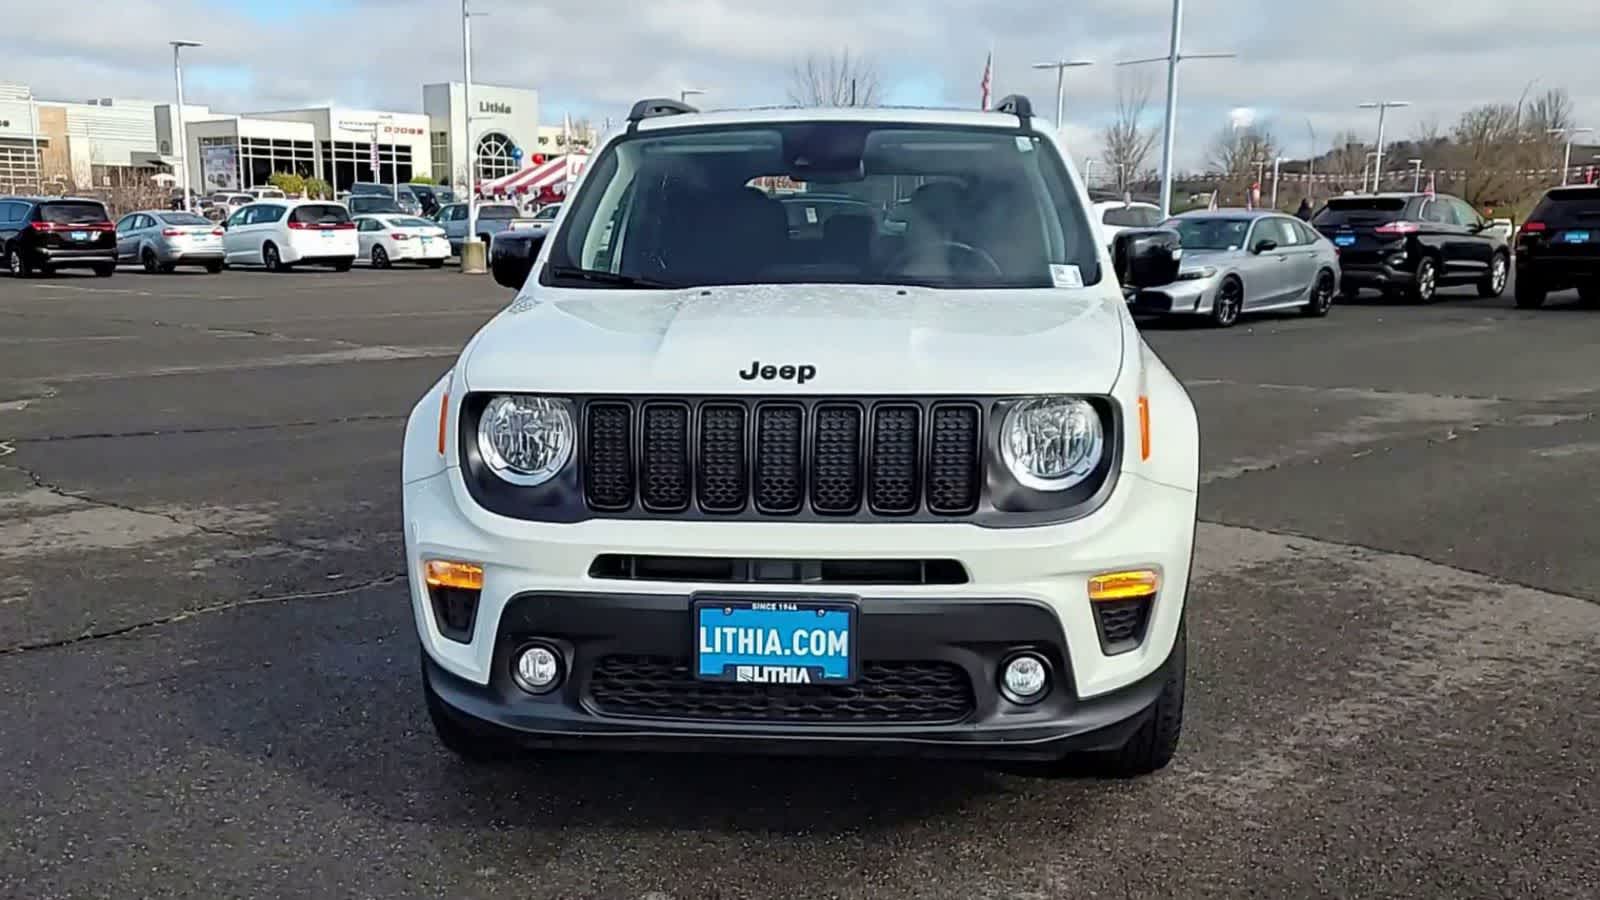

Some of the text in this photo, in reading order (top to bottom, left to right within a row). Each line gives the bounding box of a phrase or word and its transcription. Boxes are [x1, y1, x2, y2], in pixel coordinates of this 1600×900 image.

[739, 361, 816, 384] Jeep
[751, 602, 776, 611] SINCE
[700, 626, 848, 657] LITHIA.COM
[753, 666, 811, 684] LITHIA
